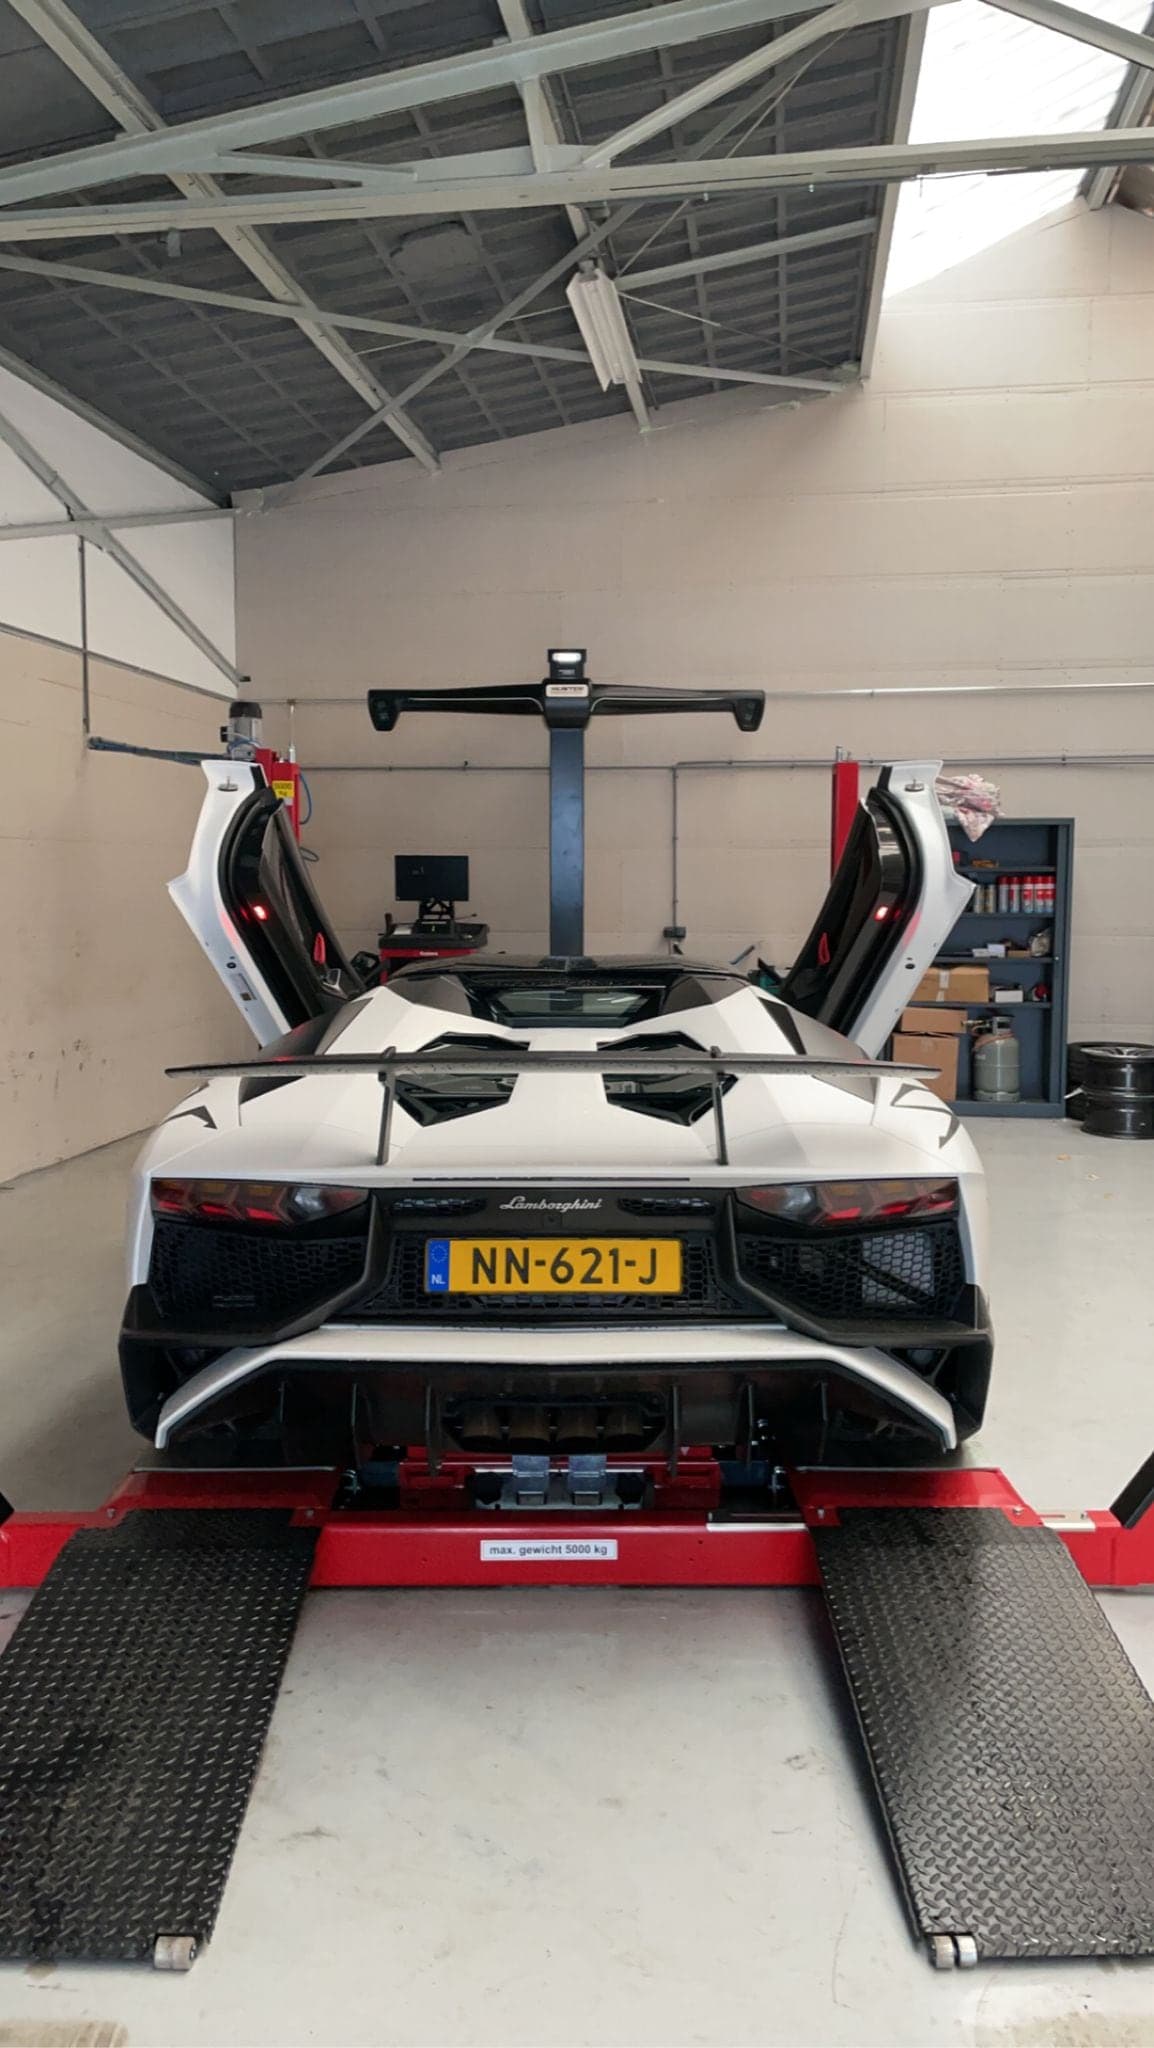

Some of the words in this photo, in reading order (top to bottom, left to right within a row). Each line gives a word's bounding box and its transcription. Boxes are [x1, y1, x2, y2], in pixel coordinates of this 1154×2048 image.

[499, 1196, 602, 1212] Lamborghini
[472, 1248, 656, 1285] NN-621-J
[431, 1275, 446, 1285] NL
[489, 1546, 515, 1554] max.
[519, 1545, 562, 1556] gewicht
[565, 1545, 591, 1554] 5000
[594, 1545, 608, 1556] kg
